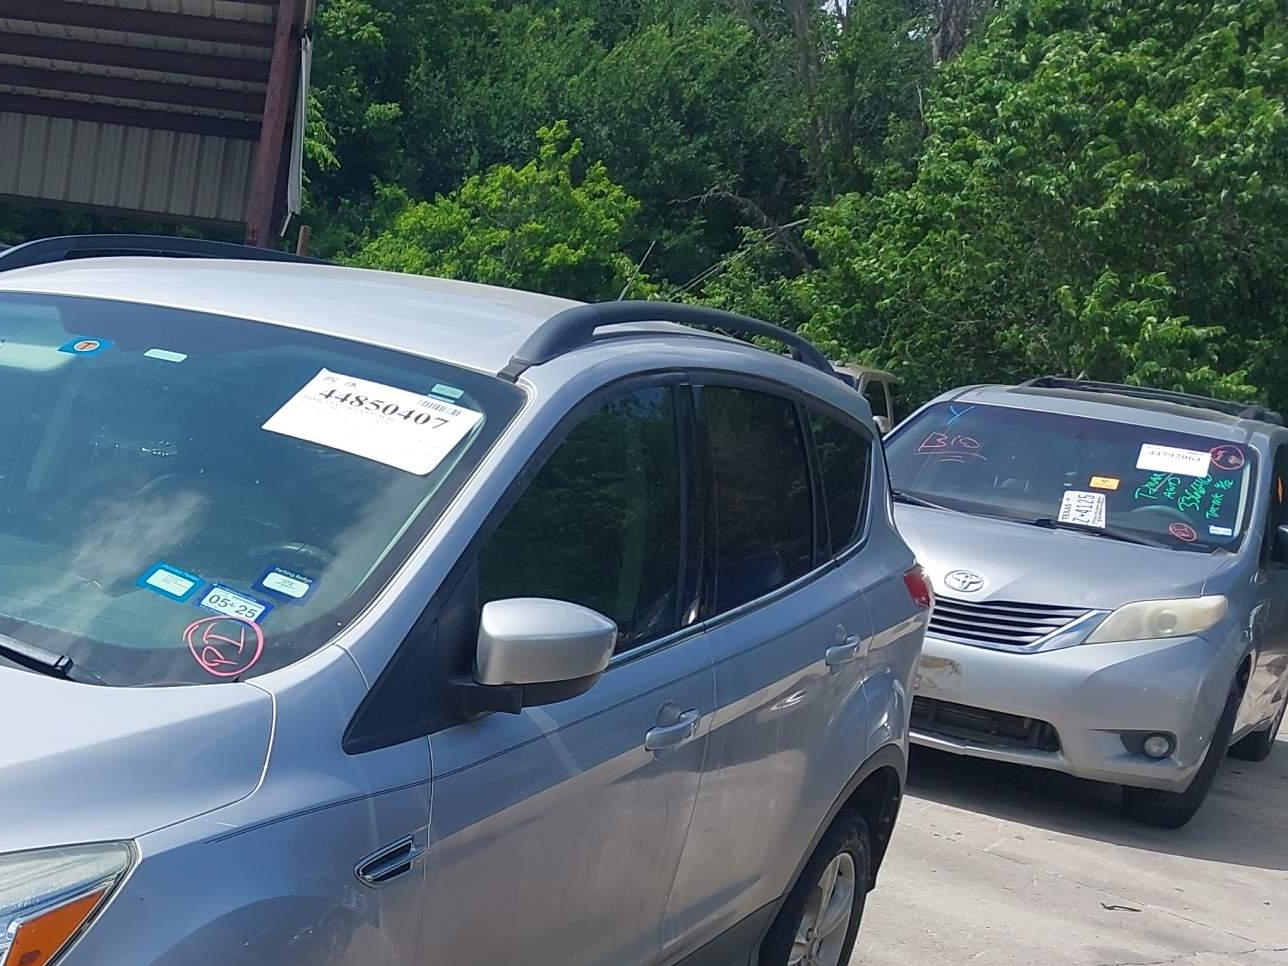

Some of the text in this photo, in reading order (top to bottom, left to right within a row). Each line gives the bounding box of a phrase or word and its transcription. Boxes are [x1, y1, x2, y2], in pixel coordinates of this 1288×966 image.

[318, 387, 450, 430] 44850407
[1061, 503, 1073, 521] TEXAS
[208, 593, 232, 608] 05
[235, 604, 258, 619] 25
